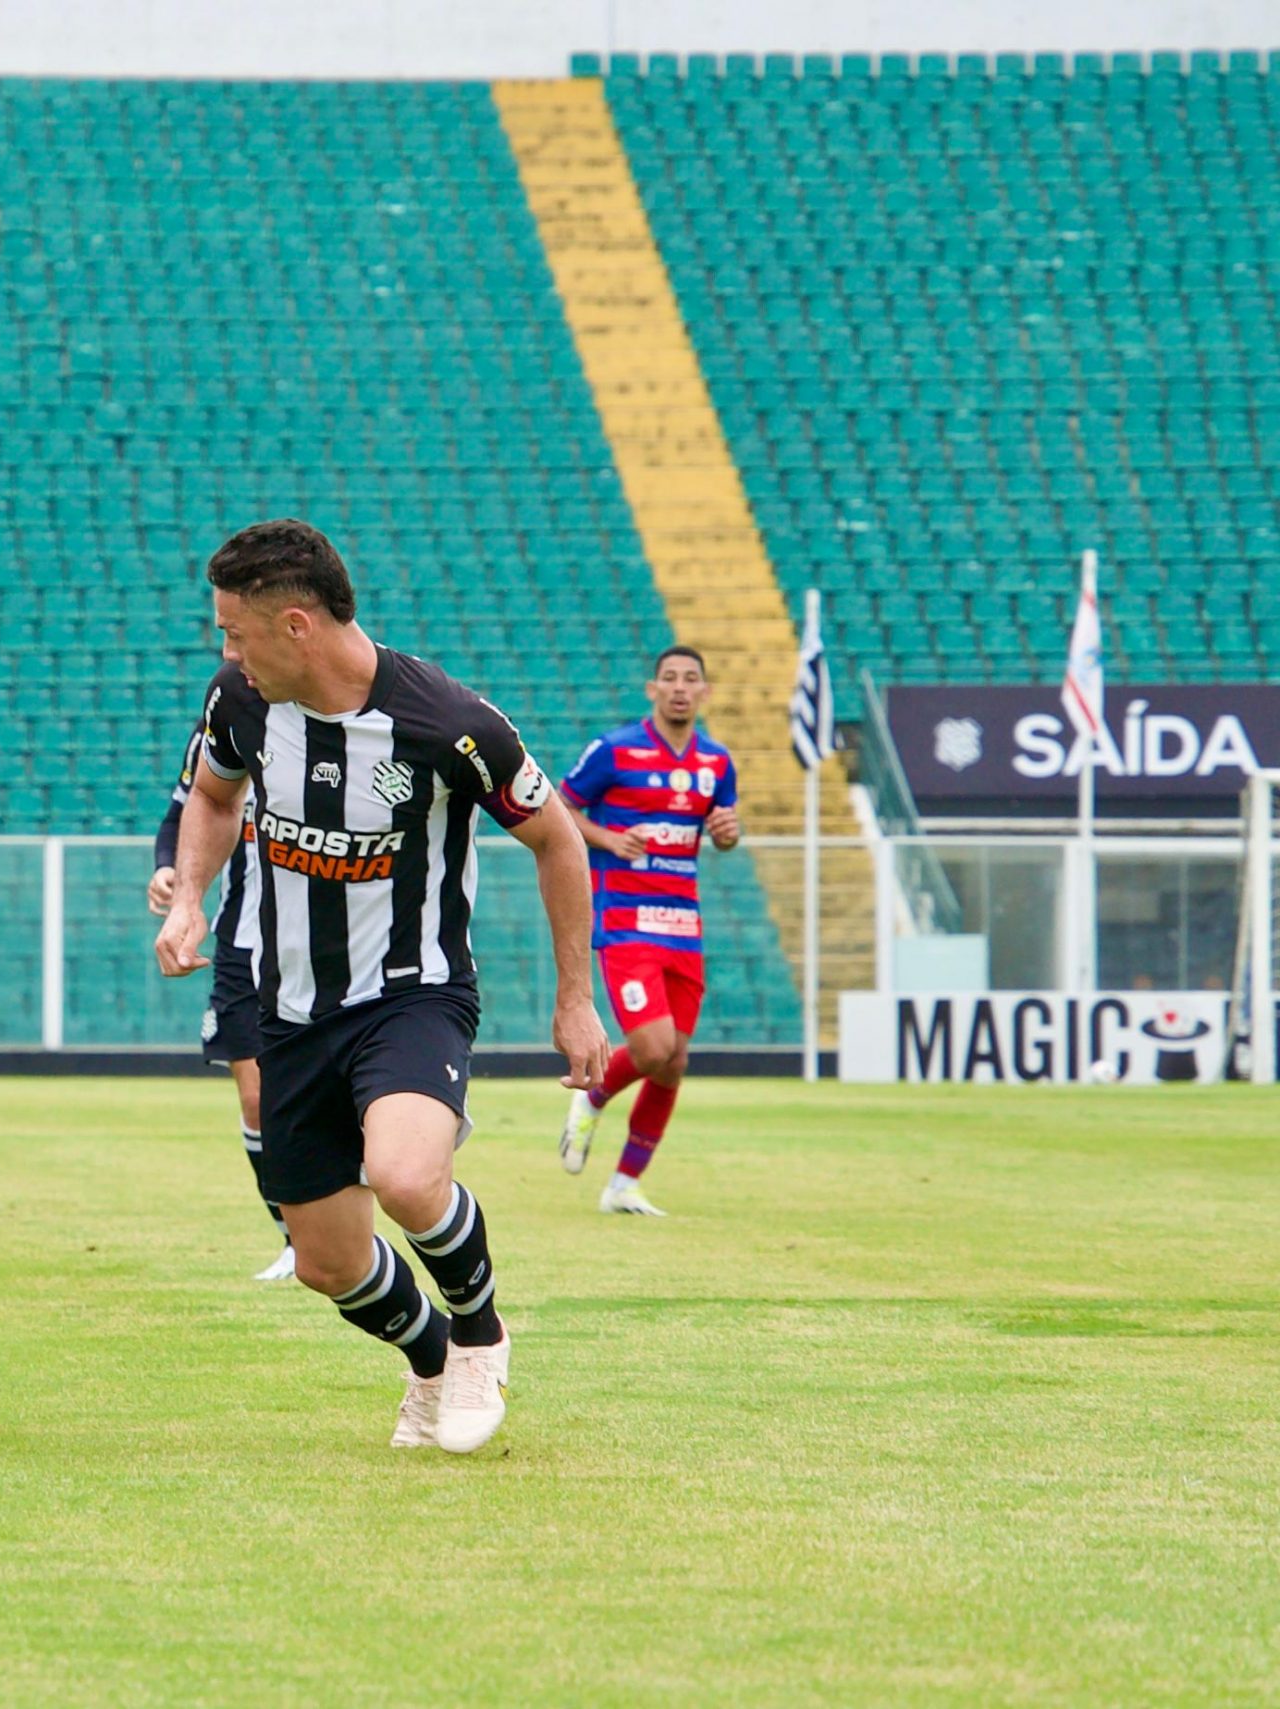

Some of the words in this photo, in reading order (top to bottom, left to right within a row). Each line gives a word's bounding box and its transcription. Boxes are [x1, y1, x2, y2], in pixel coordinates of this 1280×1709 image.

[1011, 699, 1258, 777] SAÍDA
[259, 812, 406, 857] APOSTA
[268, 840, 393, 881] GANHA
[897, 998, 1131, 1082] MAGIC
